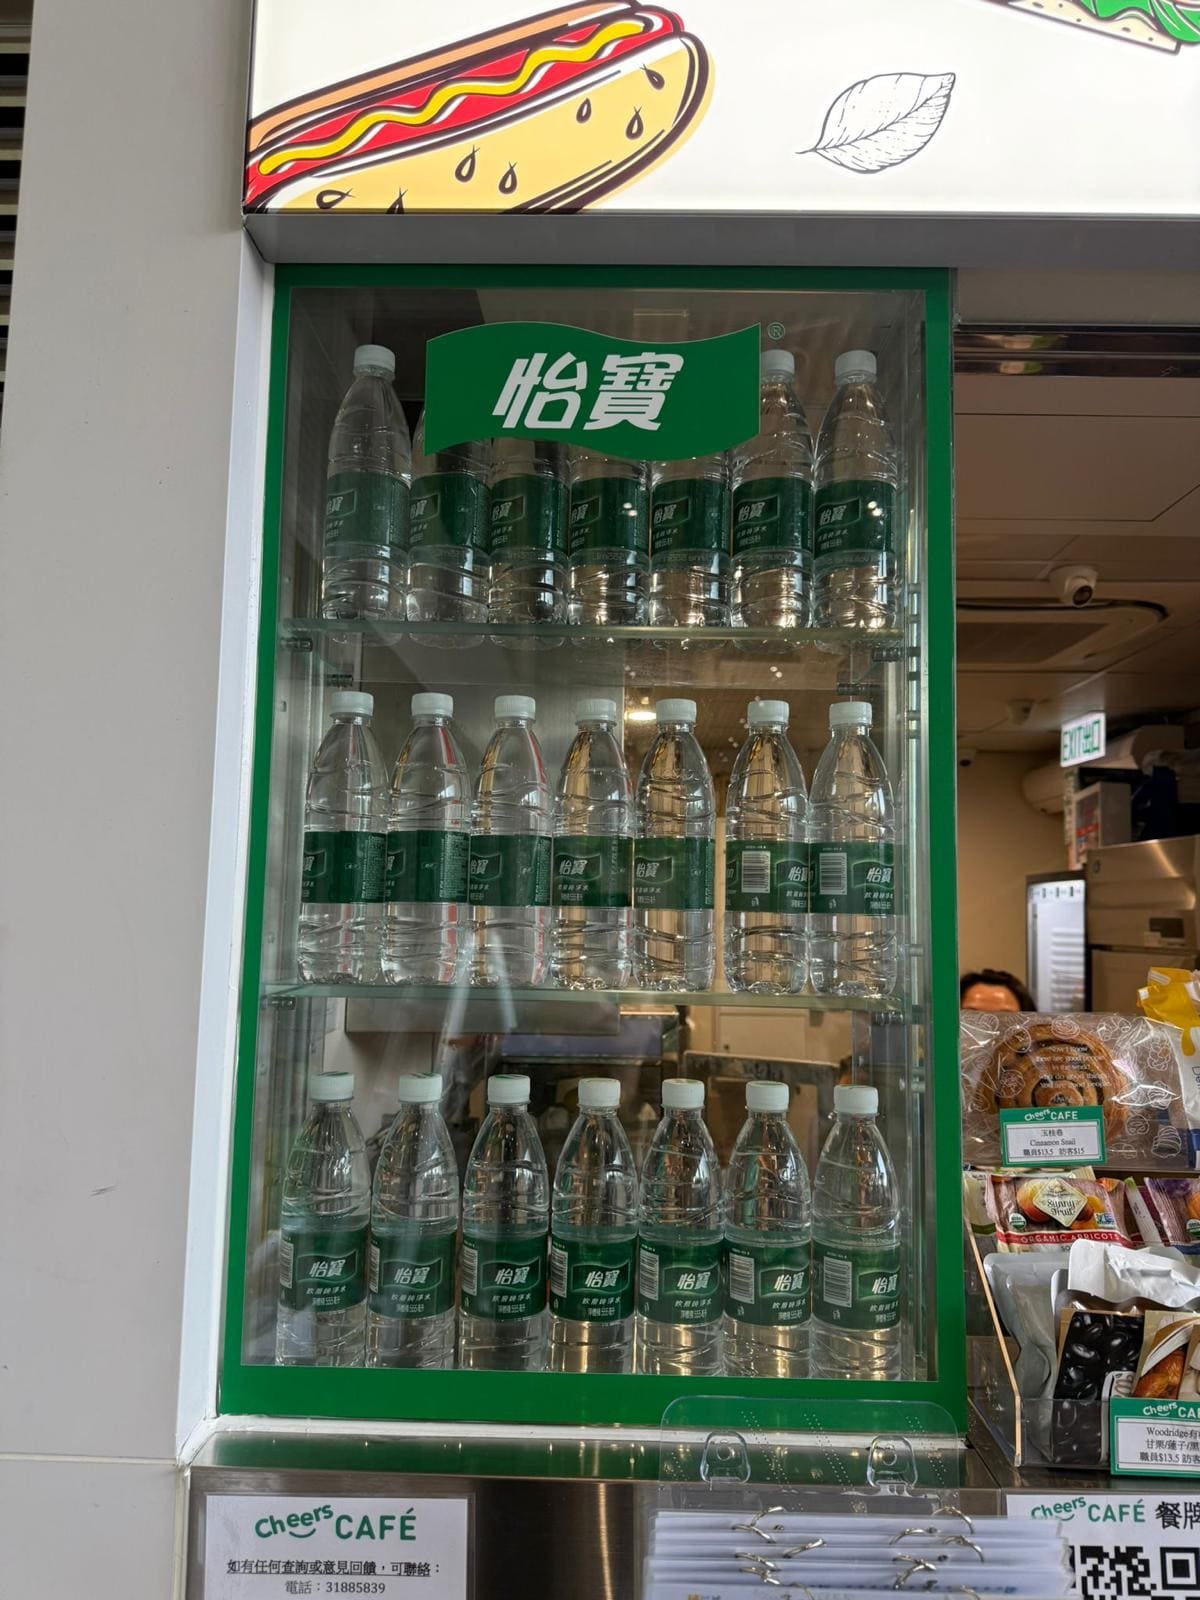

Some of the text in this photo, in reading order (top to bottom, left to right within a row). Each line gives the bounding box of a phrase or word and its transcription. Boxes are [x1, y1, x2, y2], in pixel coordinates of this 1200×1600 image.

[492, 352, 684, 431] 怡寶
[1024, 1109, 1050, 1121] Cheers
[1047, 1200, 1075, 1208] Sunny
[1050, 1206, 1074, 1216] Fruit
[1020, 1233, 1120, 1243] ORGANIC APRICOTS
[309, 1259, 346, 1278] 怡寶
[394, 1266, 430, 1285] 怡寶
[494, 1266, 530, 1285] 怡寶
[585, 1269, 621, 1288] 怡寶
[677, 1272, 711, 1290] 怡寶
[774, 1272, 804, 1291] 怡寶
[871, 1274, 898, 1294] 怡寶
[1143, 1402, 1178, 1416] Cheers
[1031, 1496, 1145, 1522] Cheers CAFÉ
[255, 1504, 417, 1541] Cheers CAFÉ
